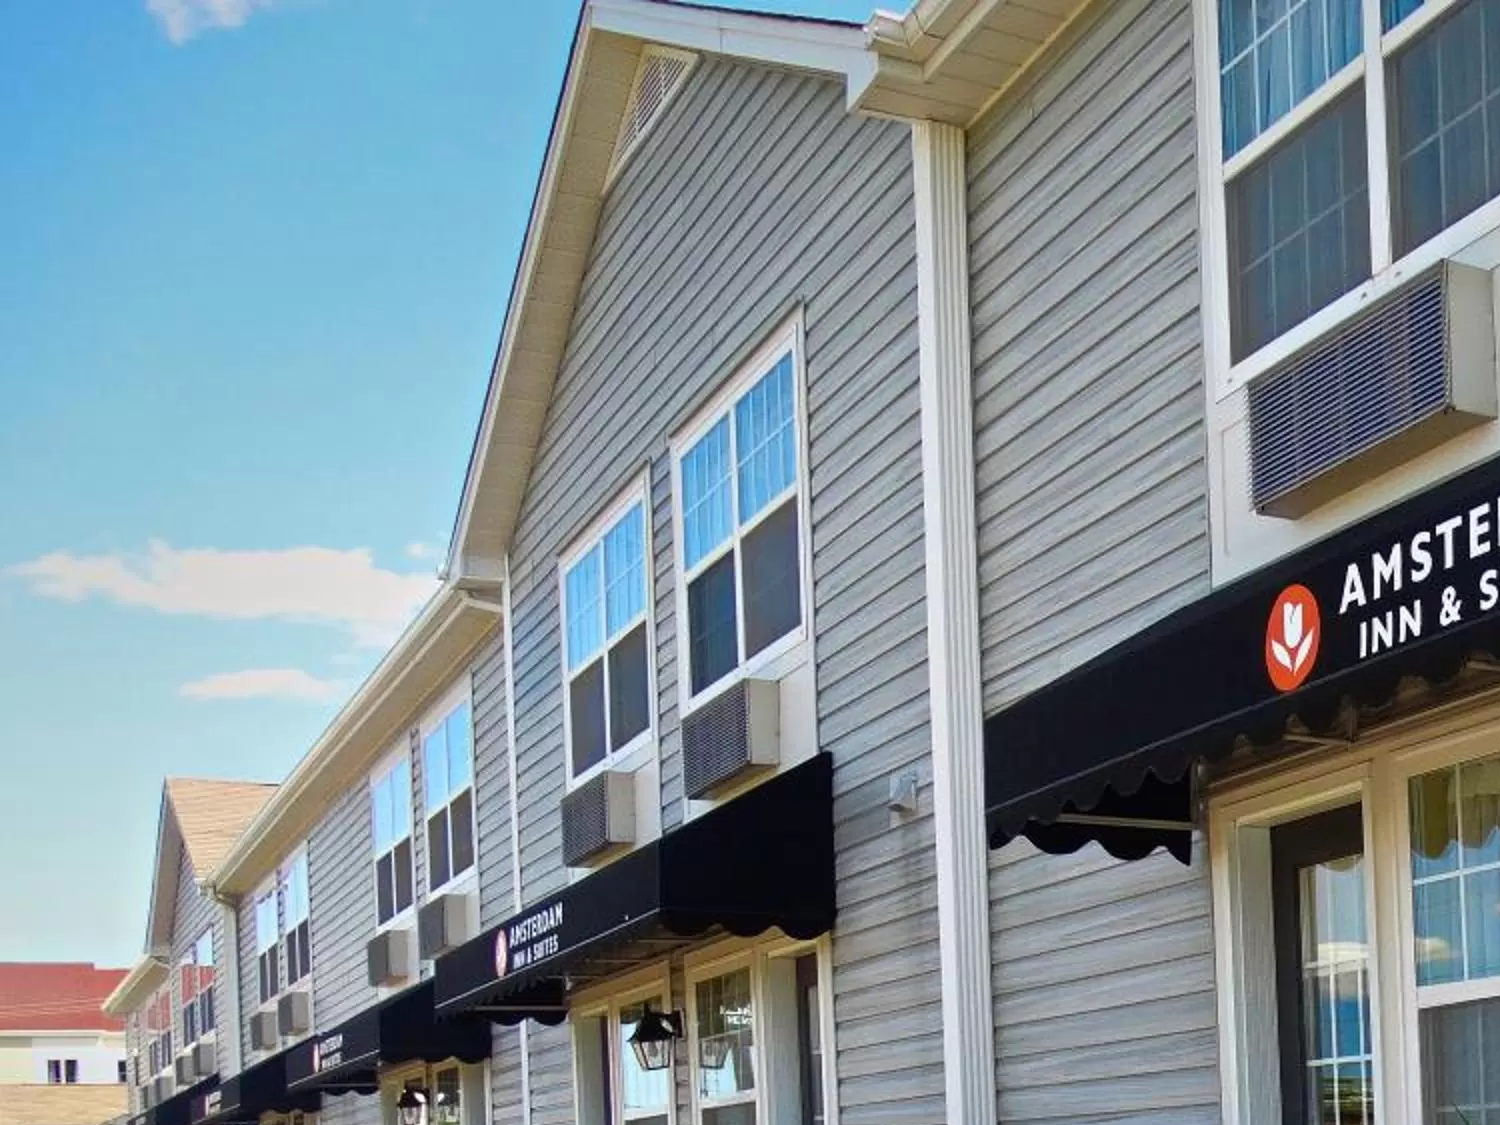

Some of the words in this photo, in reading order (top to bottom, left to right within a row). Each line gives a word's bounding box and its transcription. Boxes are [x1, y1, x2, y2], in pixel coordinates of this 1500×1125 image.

[1359, 599, 1422, 659] INN
[1439, 586, 1462, 627] &
[509, 901, 563, 949] AMSTERDAM
